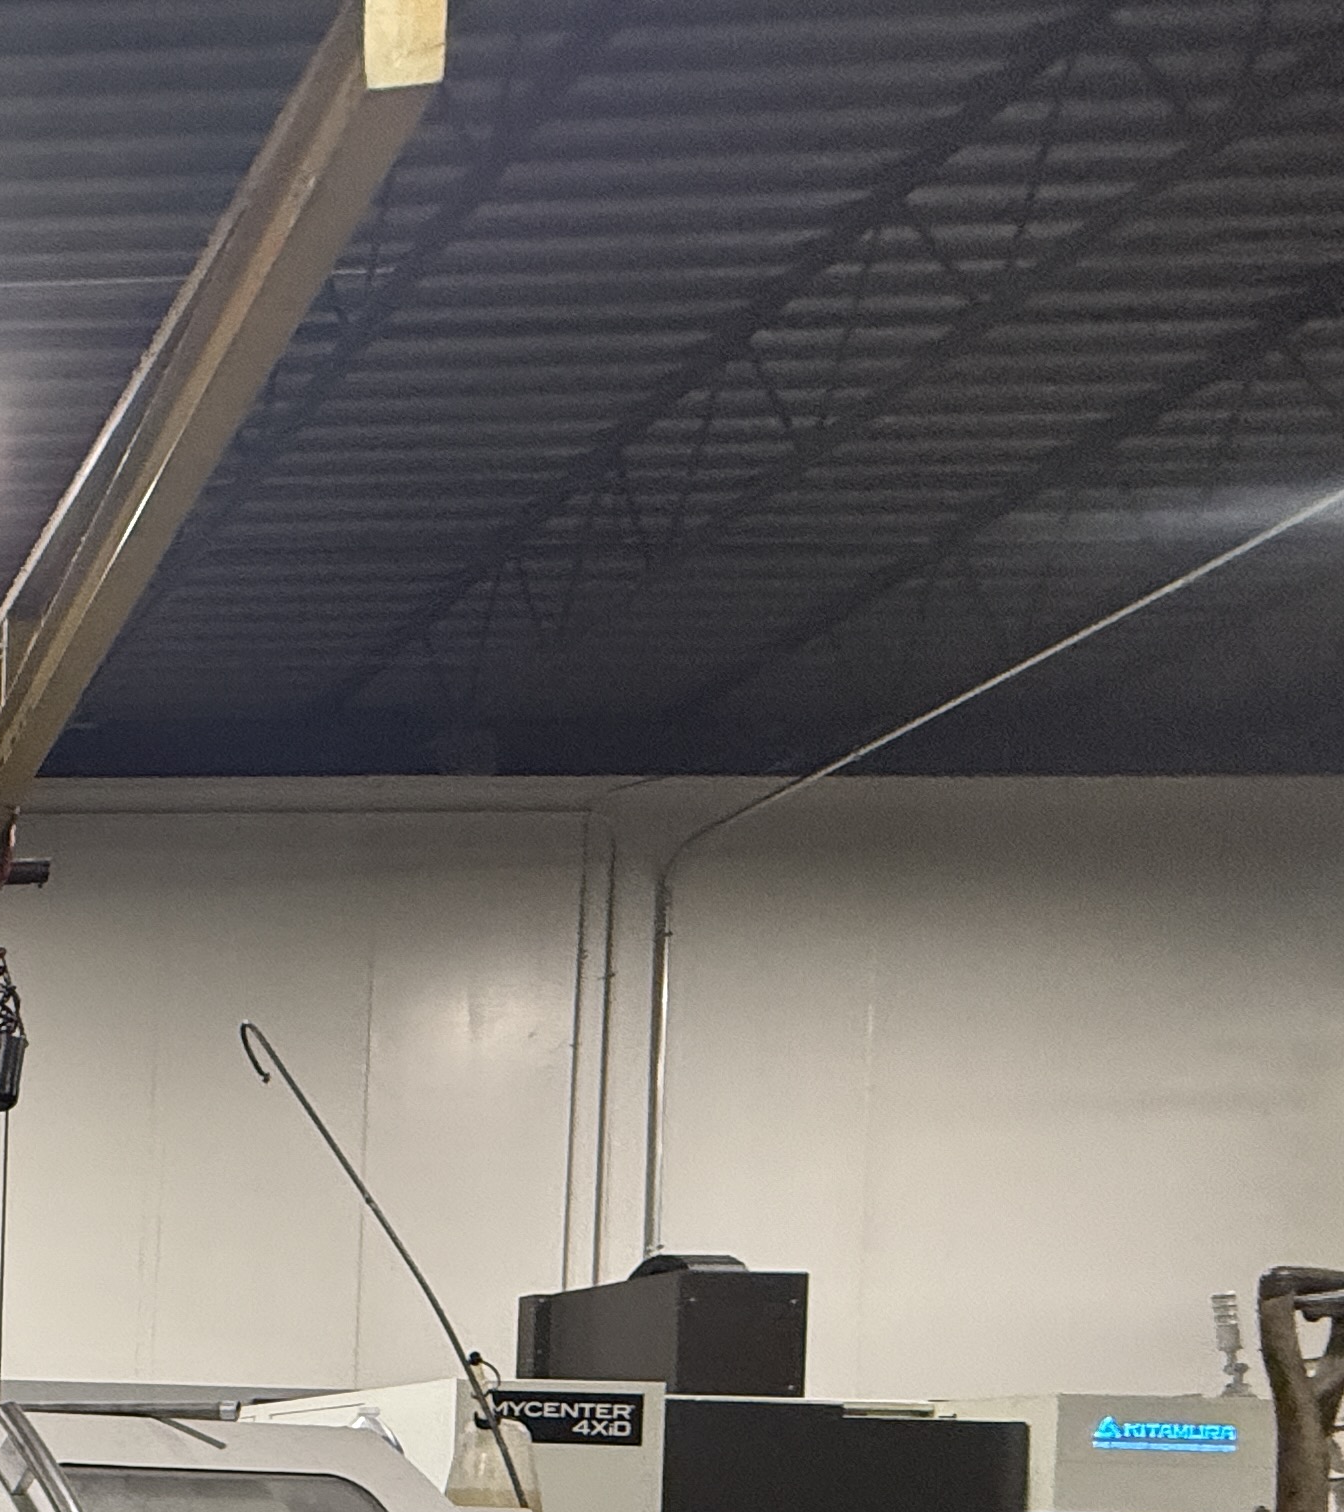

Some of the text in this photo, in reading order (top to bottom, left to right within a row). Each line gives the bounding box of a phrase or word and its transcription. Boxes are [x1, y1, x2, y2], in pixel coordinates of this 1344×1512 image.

[492, 1402, 631, 1419] MYCENTER
[572, 1420, 631, 1437] 4XiD
[1123, 1423, 1237, 1441] KITAMURA
